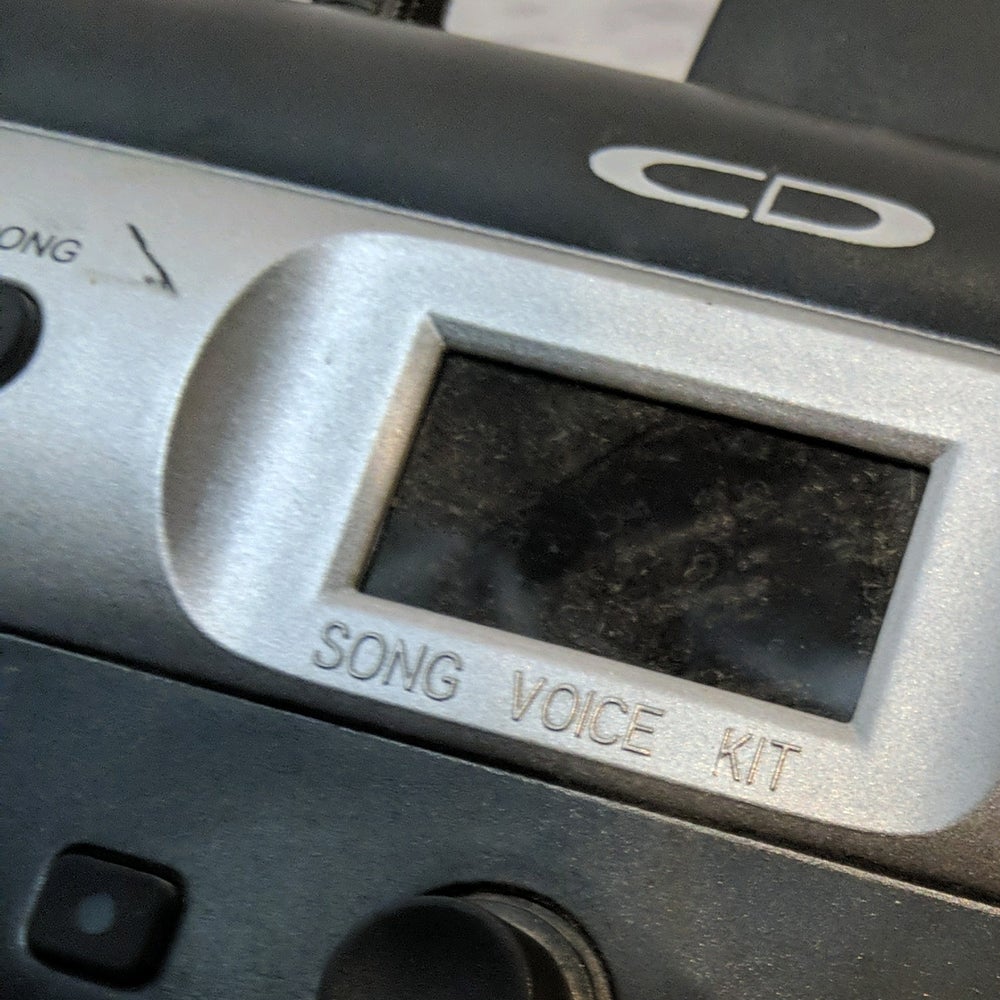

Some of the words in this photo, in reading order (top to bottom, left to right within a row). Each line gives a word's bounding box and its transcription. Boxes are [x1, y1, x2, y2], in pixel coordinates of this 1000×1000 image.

[312, 620, 464, 701] SONG
[510, 669, 665, 756] VOICE
[713, 727, 802, 791] KIT
